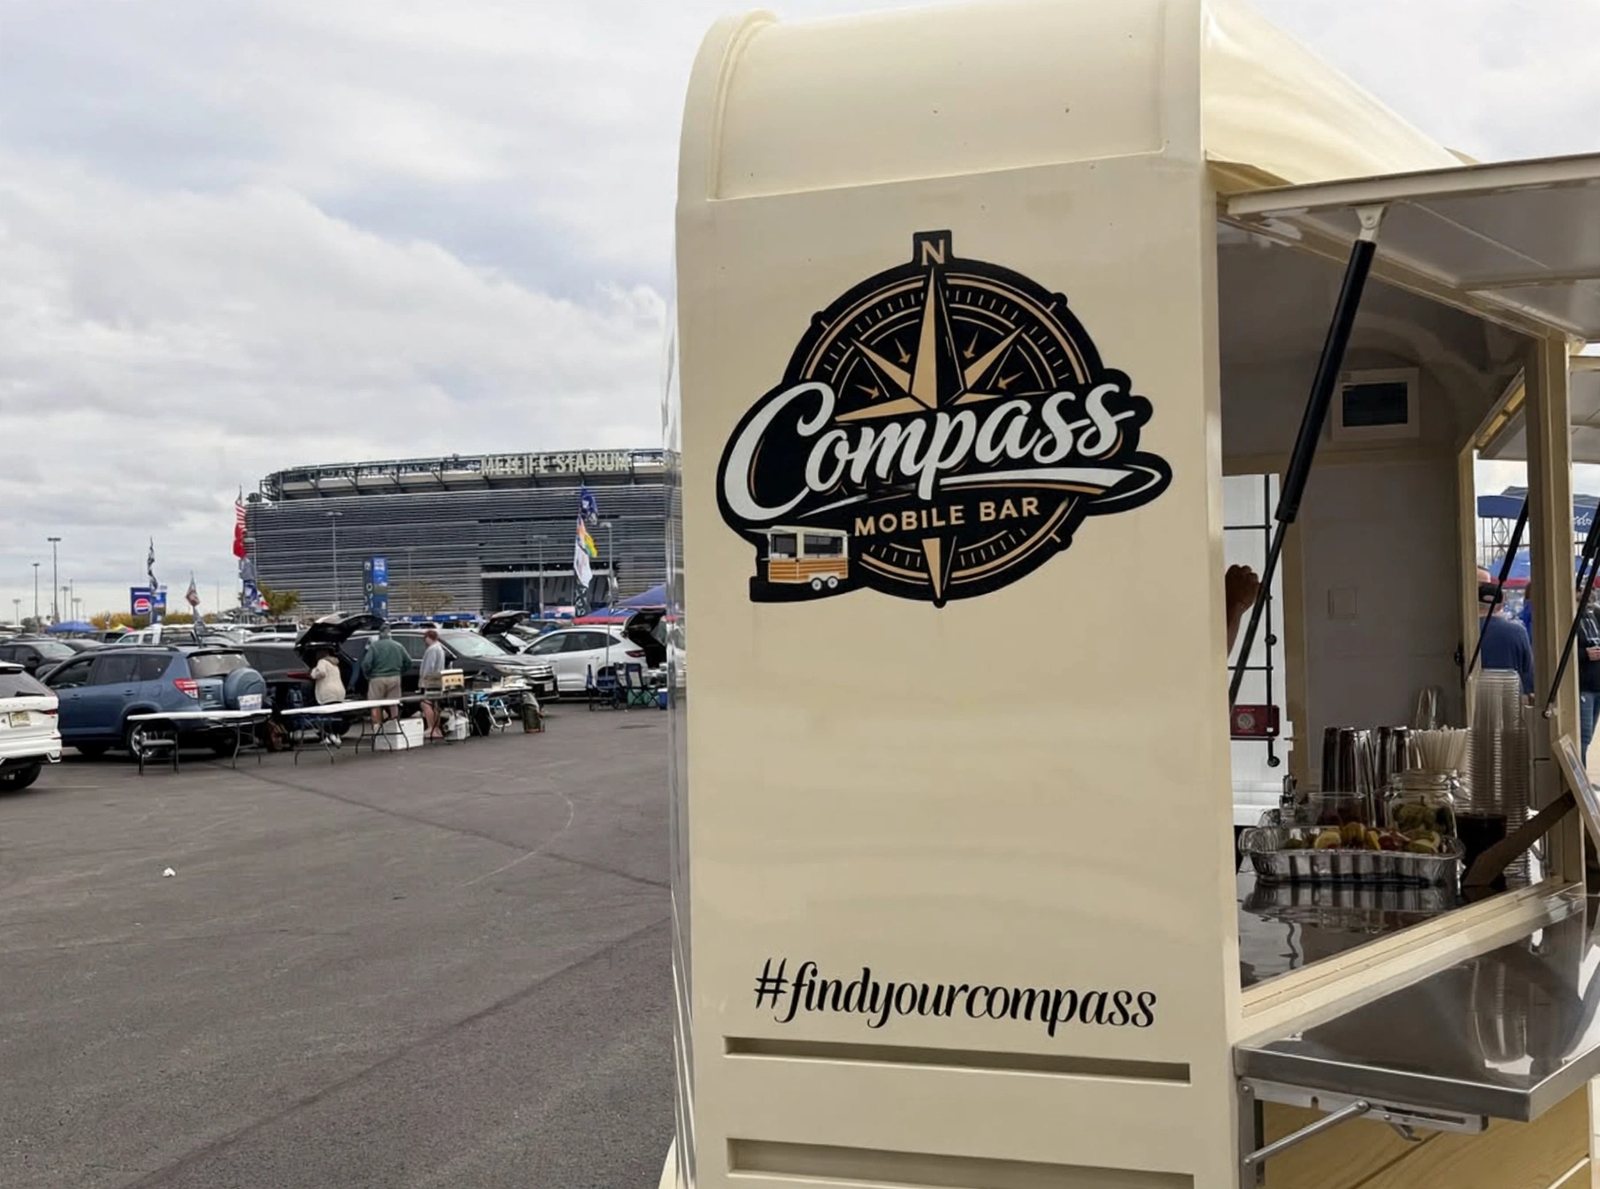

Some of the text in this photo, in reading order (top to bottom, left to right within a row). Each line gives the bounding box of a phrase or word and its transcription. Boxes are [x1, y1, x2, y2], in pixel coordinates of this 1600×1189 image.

[921, 239, 946, 265] N
[556, 452, 633, 472] STADIUM
[724, 381, 1136, 521] Compass
[854, 498, 1040, 537] MOBILE BAR
[754, 957, 1157, 1037] #findyourcompass
